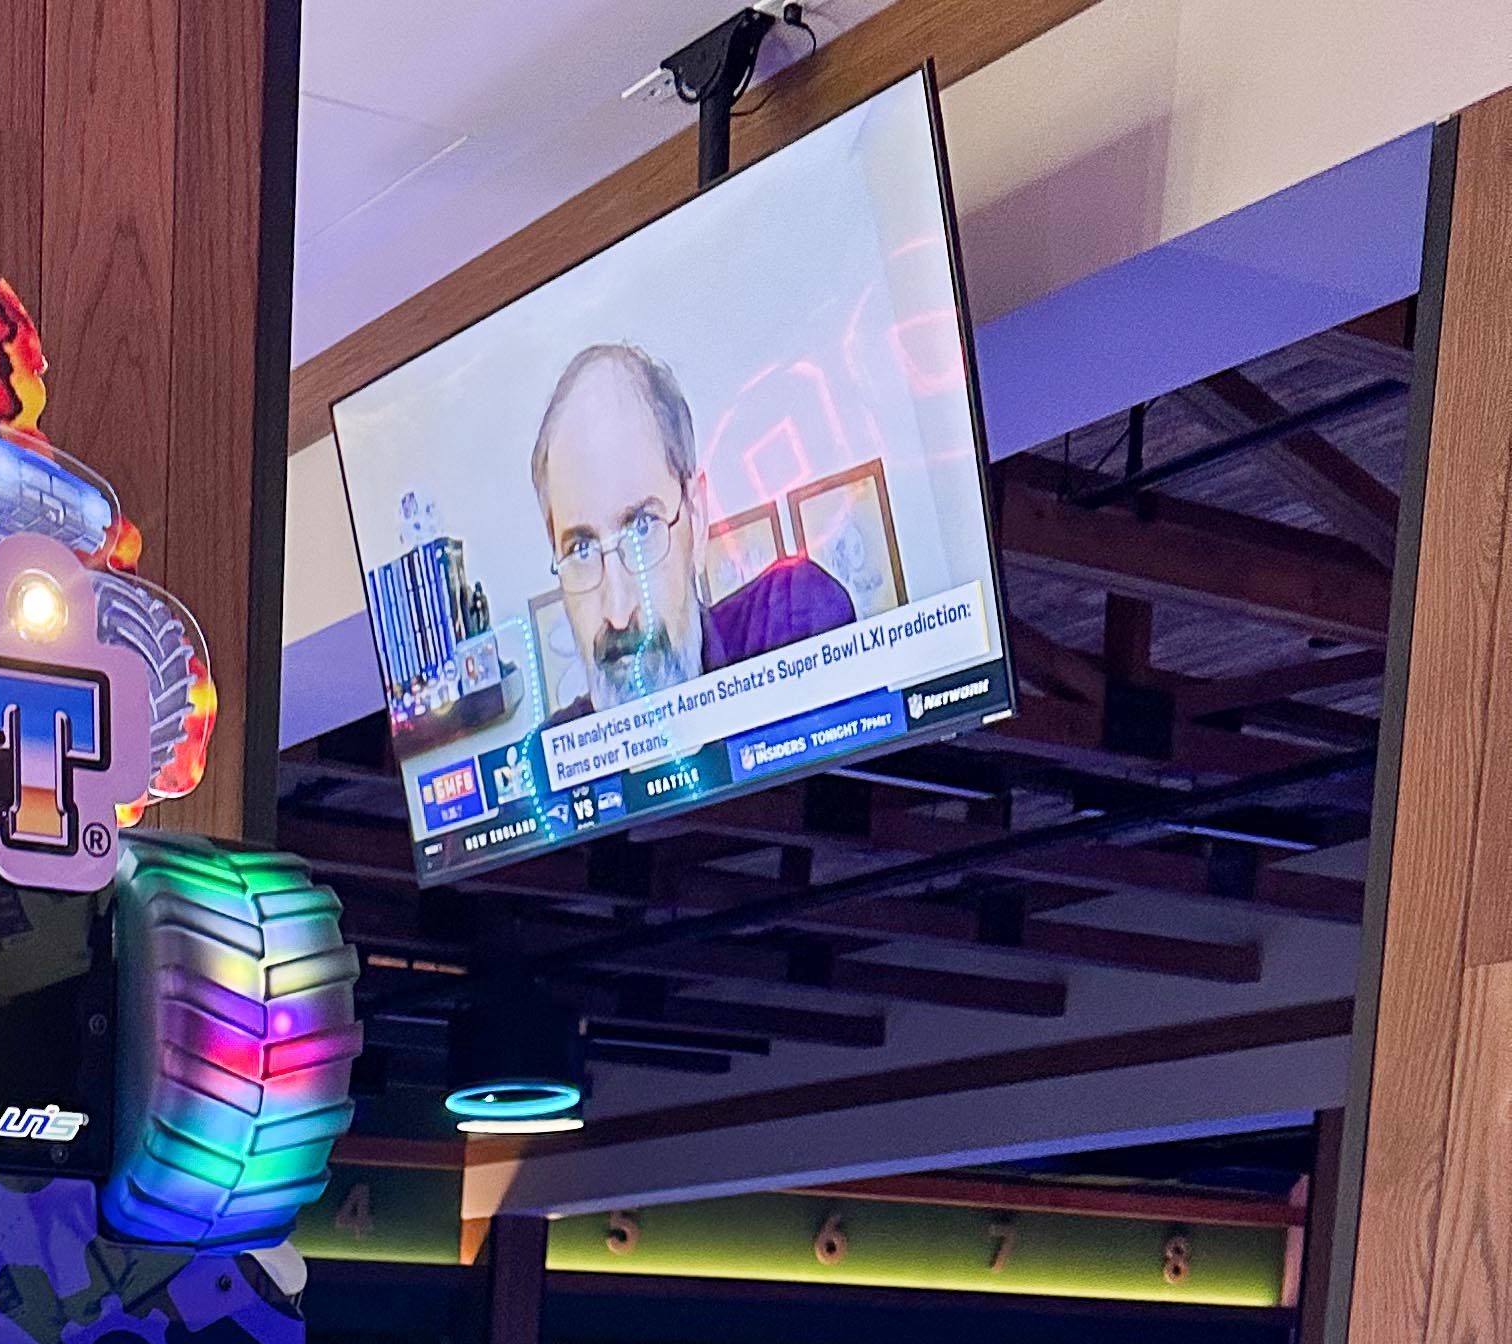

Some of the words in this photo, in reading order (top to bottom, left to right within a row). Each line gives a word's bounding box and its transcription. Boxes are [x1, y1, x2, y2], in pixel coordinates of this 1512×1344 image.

[552, 730, 575, 755] FTN
[578, 717, 631, 749] analytics
[634, 701, 674, 729] expert
[677, 688, 716, 714] Aaron
[717, 666, 776, 701] Schatz's
[778, 652, 818, 680] Super
[822, 634, 858, 665] Bowl
[861, 626, 885, 652] LXI
[888, 602, 972, 648] prediction:
[557, 756, 591, 780] Rams
[593, 748, 619, 769] over
[622, 731, 669, 759] Texans
[810, 720, 858, 746] TONIGHT
[646, 767, 700, 796] SEATTLE
[573, 798, 595, 820] VS
[606, 1210, 640, 1255] 5
[814, 1214, 849, 1266] 6
[988, 1224, 1017, 1274] 7
[1163, 1236, 1190, 1285] 8
